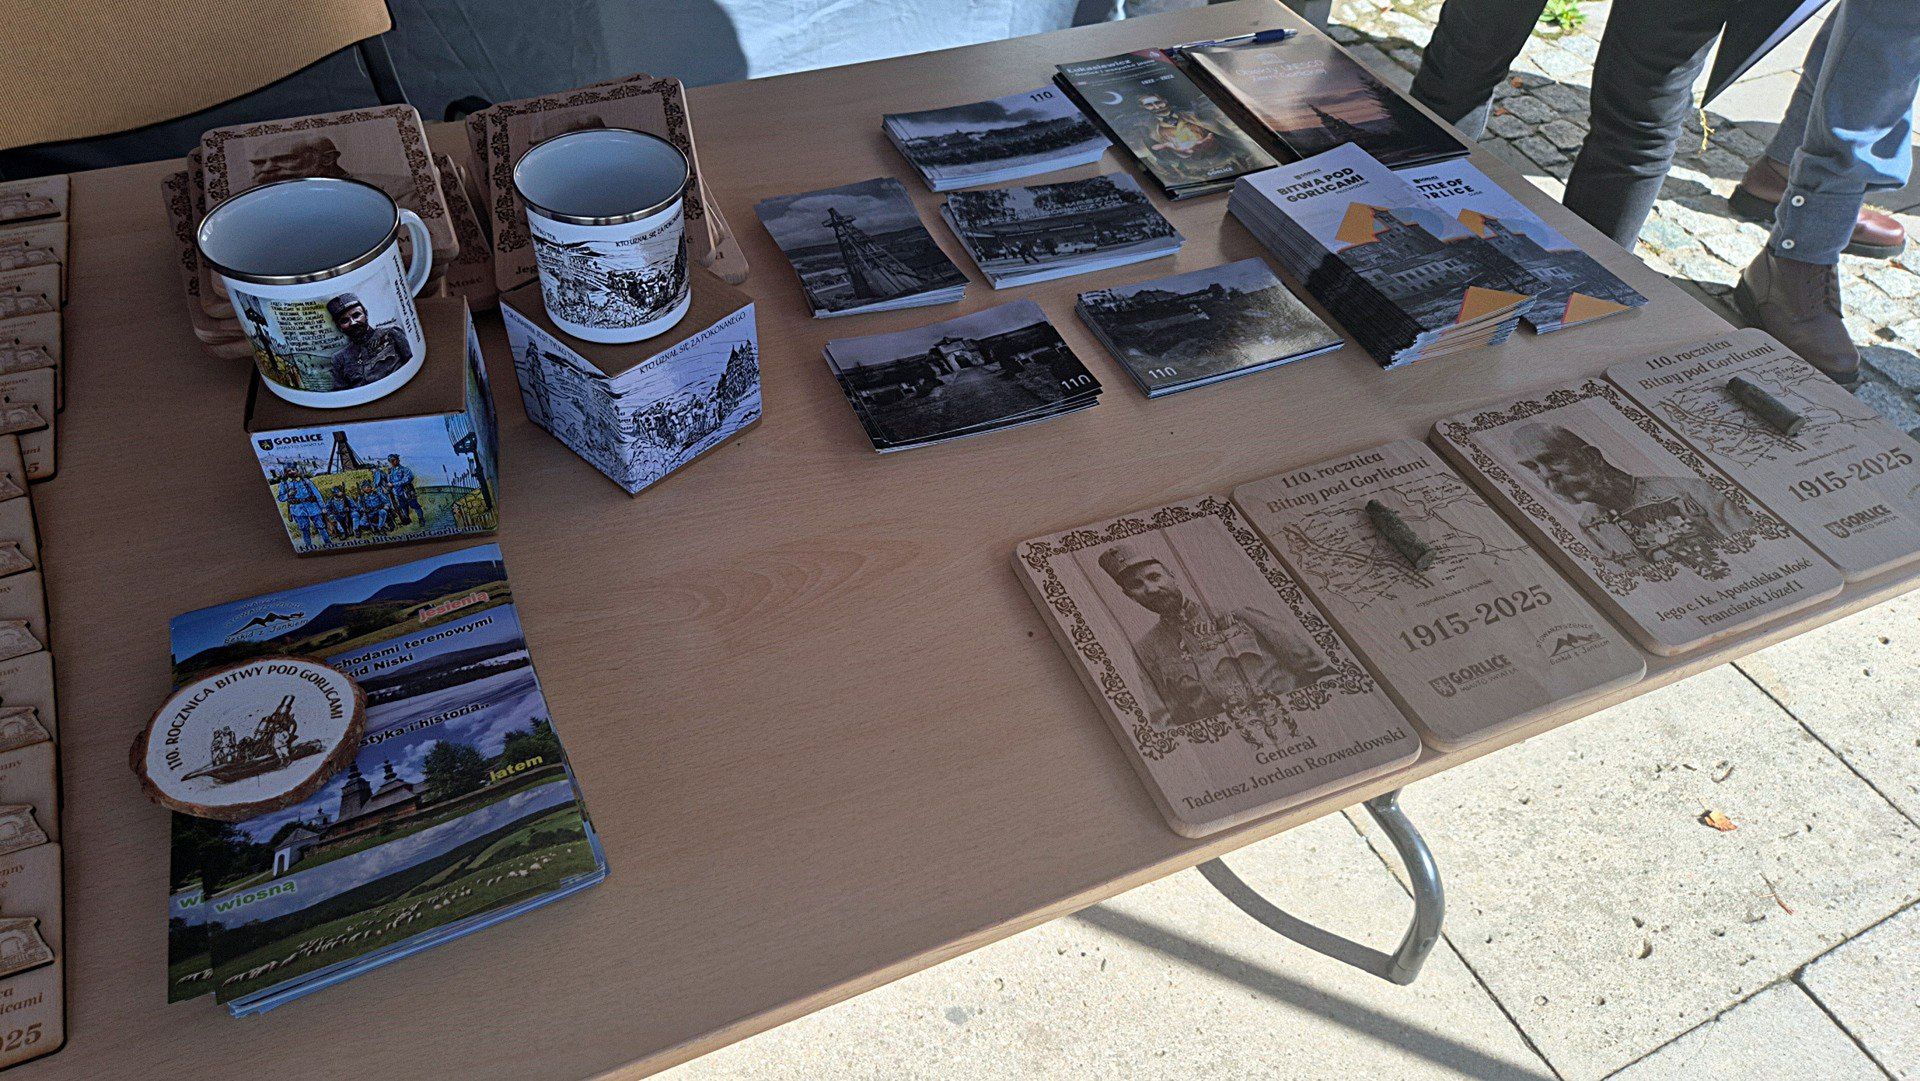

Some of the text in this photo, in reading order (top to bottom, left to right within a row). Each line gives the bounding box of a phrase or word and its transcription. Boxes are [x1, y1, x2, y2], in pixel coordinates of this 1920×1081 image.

[1029, 91, 1053, 102] 110
[1276, 167, 1354, 196] BITWA POD
[1286, 174, 1365, 203] GORLICAMI
[1417, 178, 1464, 193] TTLE OF
[516, 265, 539, 275] Jeg
[639, 362, 655, 375] KTO
[656, 350, 679, 366] UZNAŁ
[689, 337, 701, 347] ZA
[700, 311, 746, 342] POKONANEGO
[1646, 339, 1733, 371] 110. rocznica
[1148, 366, 1178, 379] 110
[1638, 343, 1776, 392] Bitwy pod Gorlicami
[273, 433, 324, 446] GORLICE
[1266, 457, 1431, 514] Bitwy pod Gorlicami
[1281, 450, 1384, 490] 110. rocznica
[1787, 447, 1913, 503] 1915-2025
[1839, 504, 1893, 528] GORLICE
[322, 538, 371, 550] rocznica
[372, 534, 402, 545] Bitwy
[406, 530, 426, 543] pod
[1655, 606, 1687, 622] Jego
[1716, 570, 1781, 601] Apostolska
[1779, 556, 1814, 578] Mość
[1697, 595, 1766, 626] Franciszek
[1767, 583, 1797, 603] Józef
[418, 590, 490, 623] jesienią
[1398, 584, 1553, 653] 1915-2025
[333, 616, 493, 670] chodami terenowymi
[374, 652, 413, 671] Niski
[1448, 653, 1512, 684] GORLICE
[165, 664, 343, 772] 110. ROCZNICA BITWY POD GORLICAMI
[358, 727, 405, 749] styka
[409, 722, 415, 732] i
[1255, 736, 1319, 765] Generał
[489, 755, 544, 782] latem
[1182, 726, 1408, 811] Tadeusz Jordan Rozwadowski
[215, 881, 297, 913] wiosną
